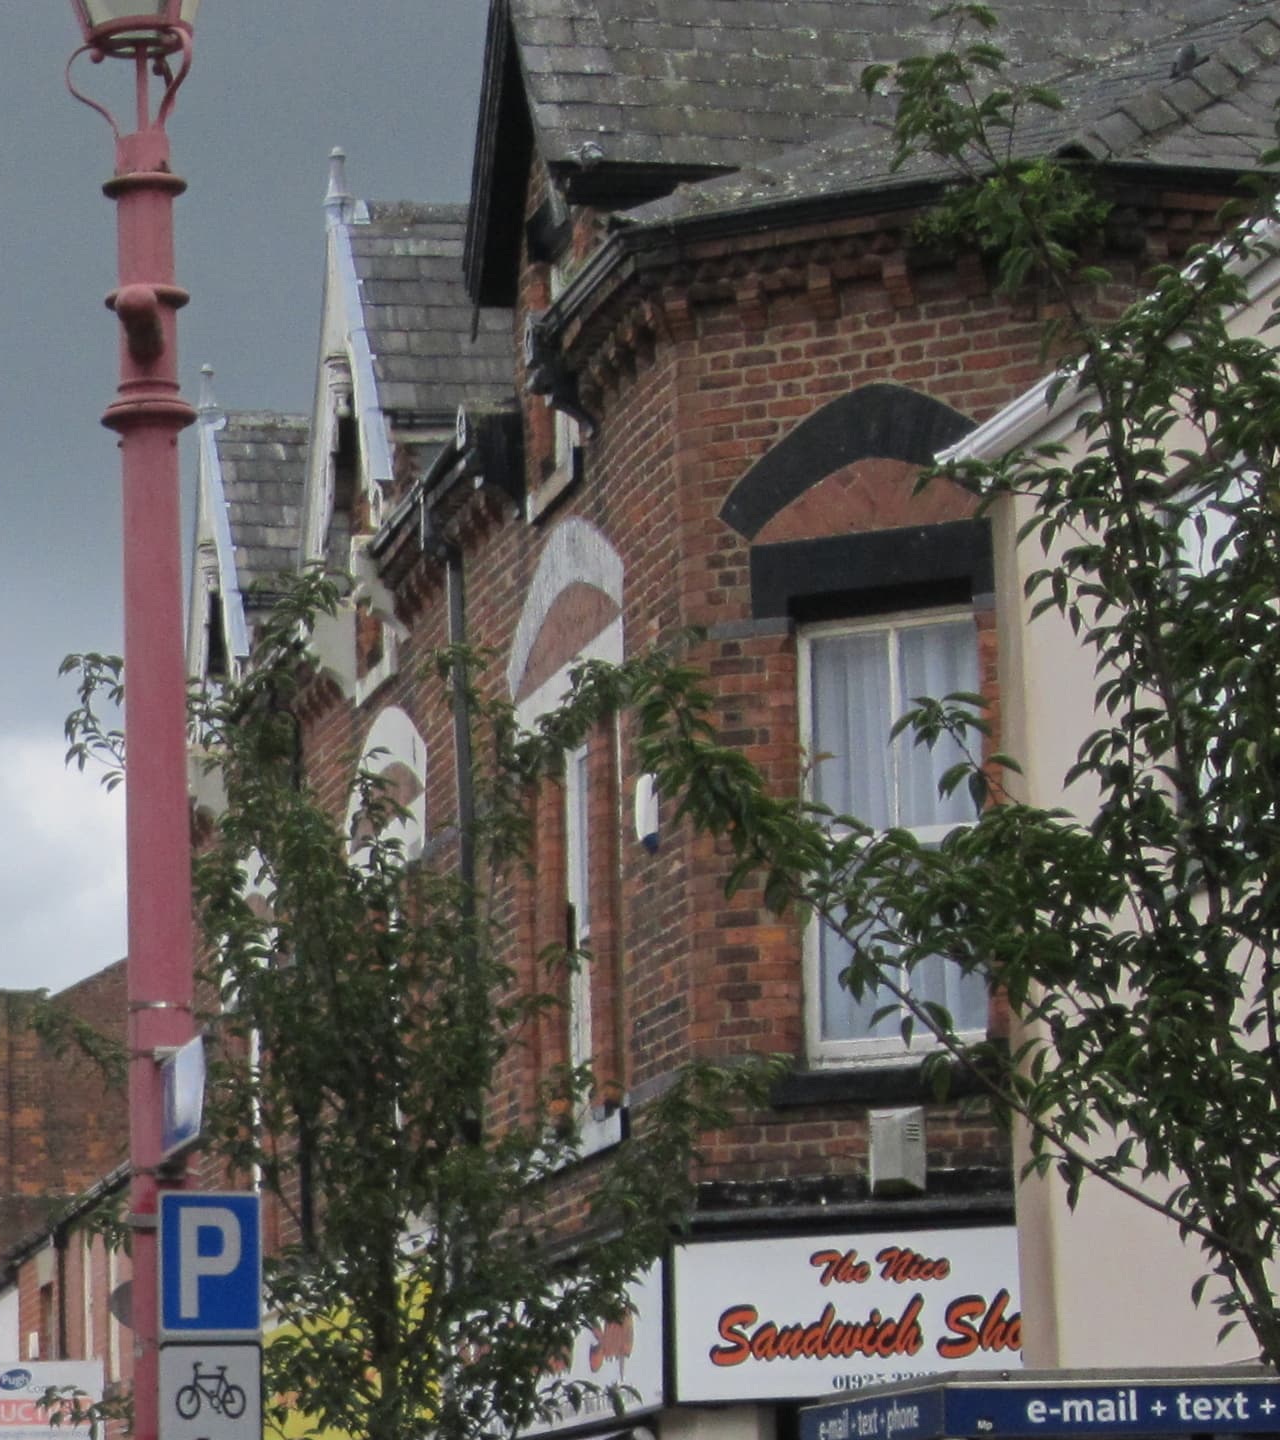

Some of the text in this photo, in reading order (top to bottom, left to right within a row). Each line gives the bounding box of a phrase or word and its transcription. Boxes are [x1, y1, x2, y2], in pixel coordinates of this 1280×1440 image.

[179, 1206, 240, 1319] P
[809, 1246, 951, 1286] The Nice
[709, 1293, 923, 1367] Sandwich
[937, 1288, 1024, 1359] Sho
[2, 1372, 29, 1388] Pugh
[857, 1408, 878, 1436] text
[887, 1400, 920, 1439] phone
[1027, 1389, 1138, 1423] e-mail
[1177, 1392, 1250, 1421] text
